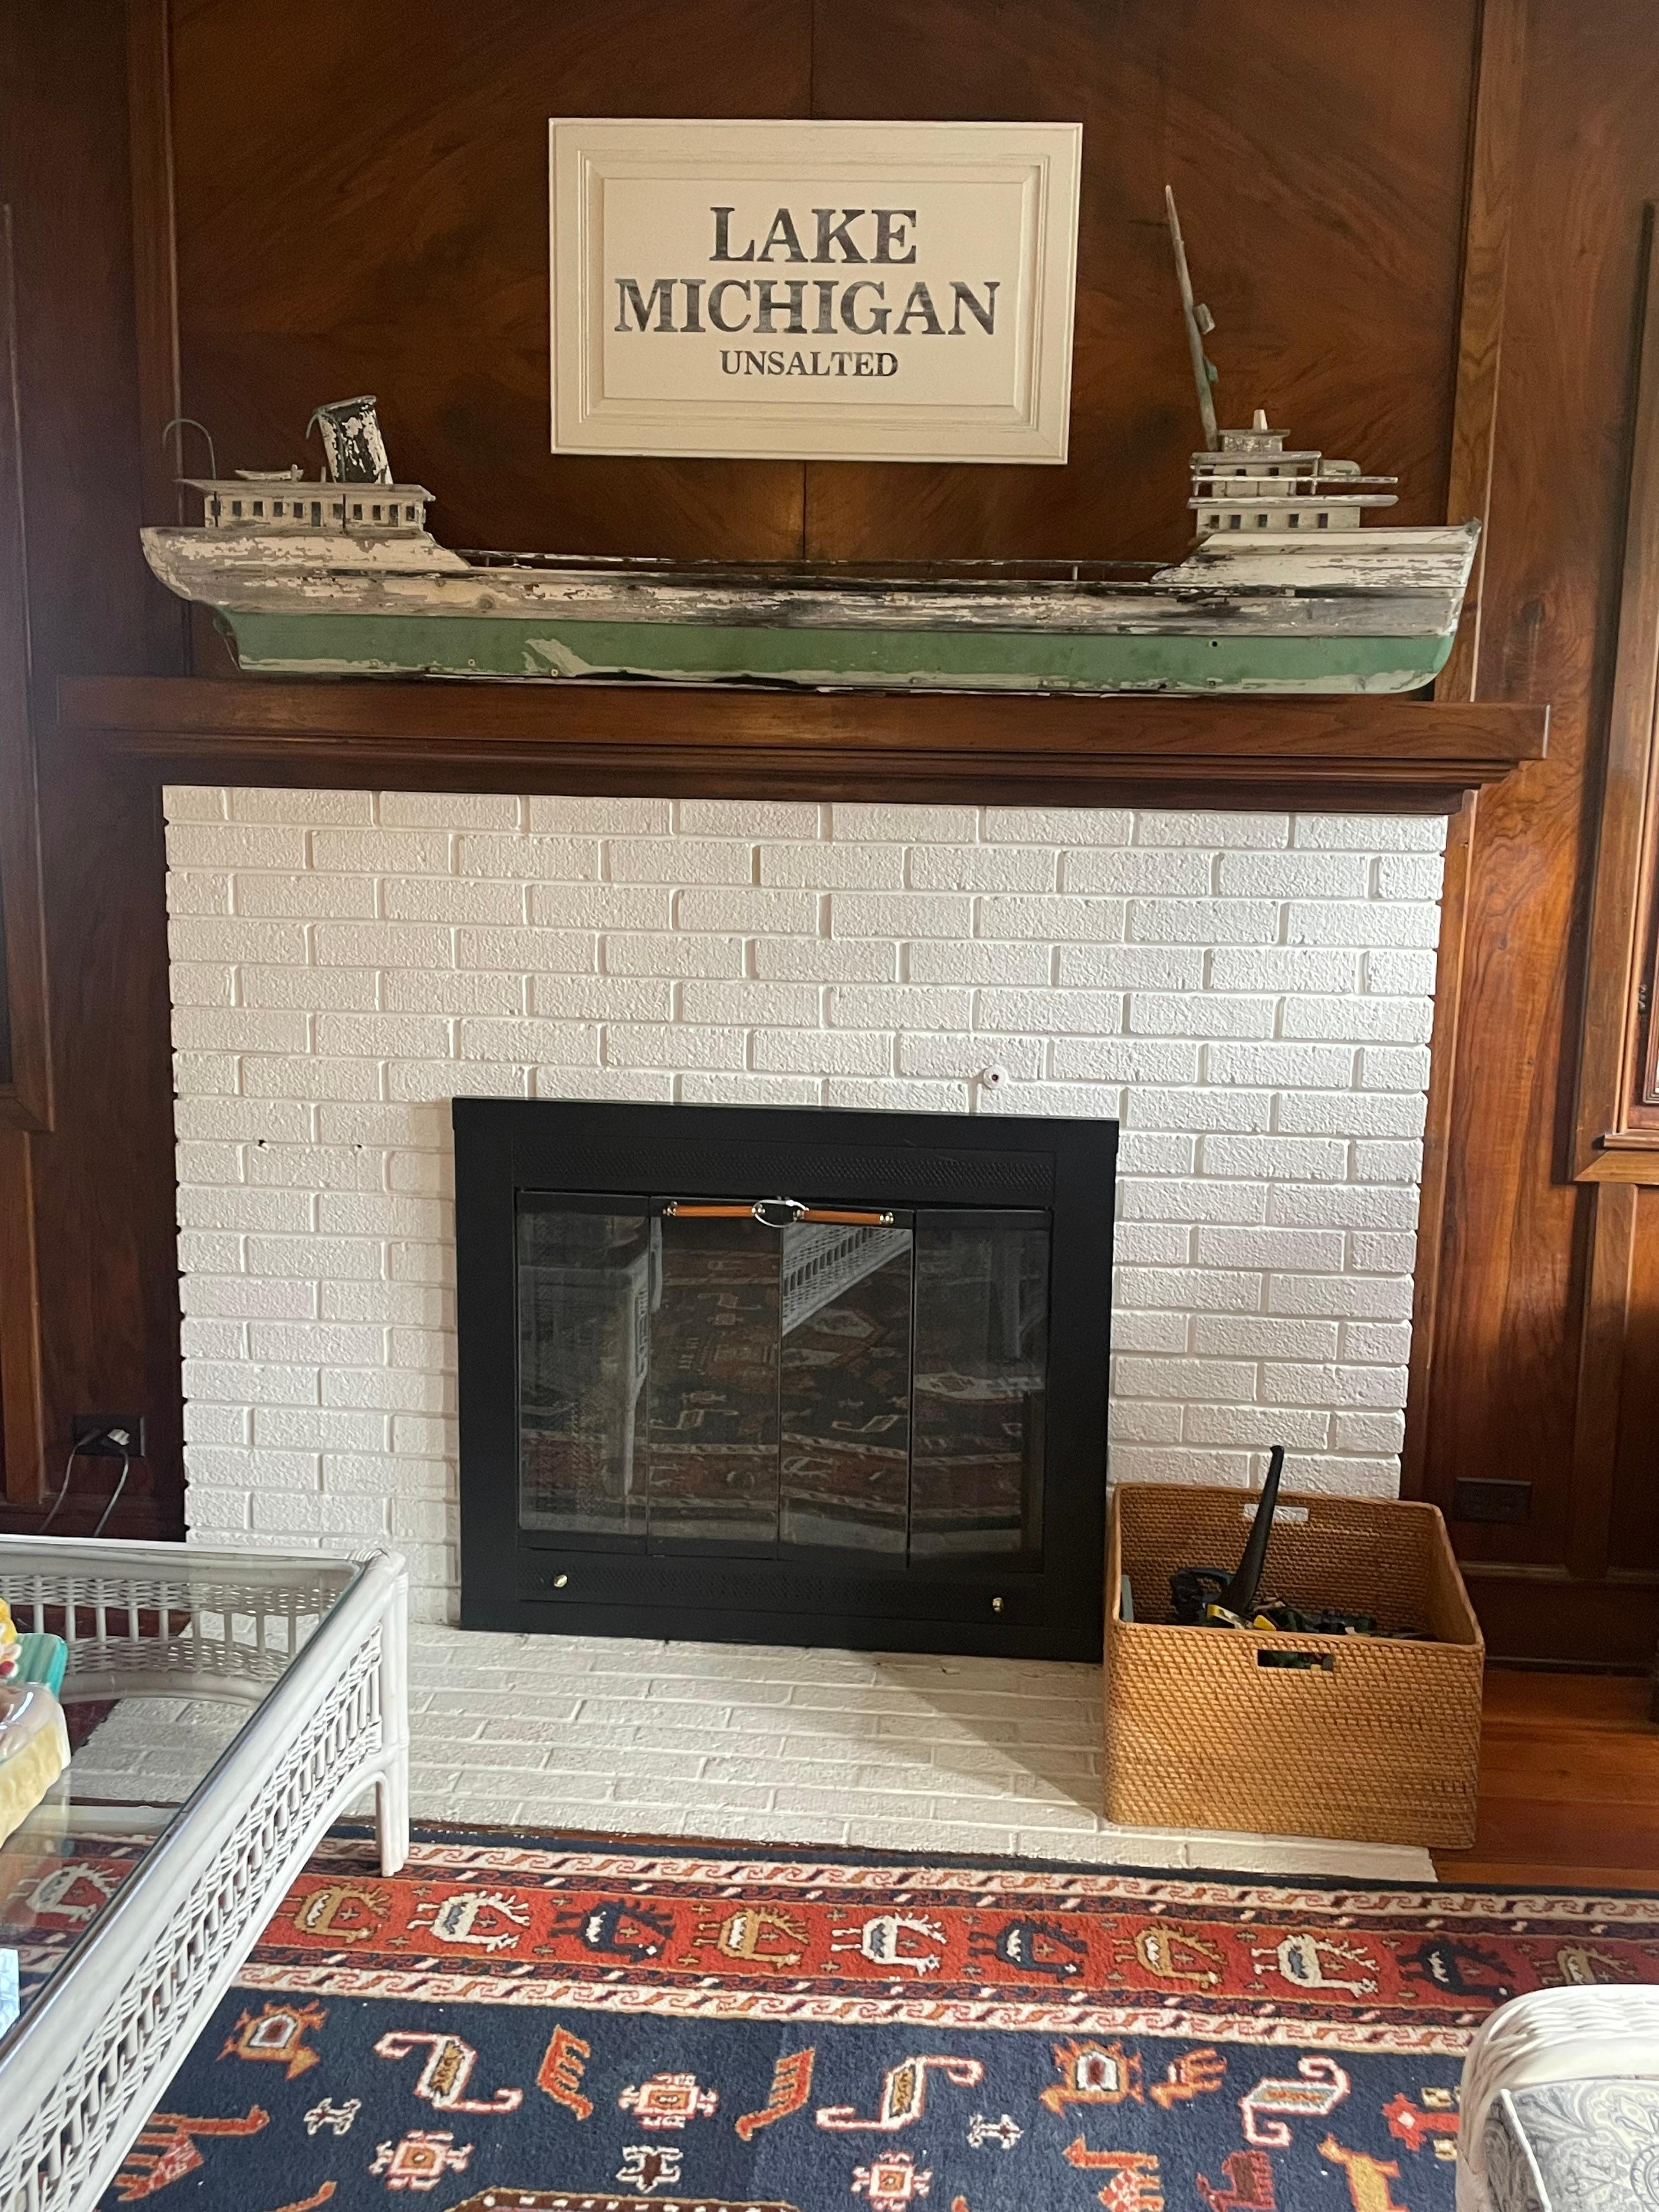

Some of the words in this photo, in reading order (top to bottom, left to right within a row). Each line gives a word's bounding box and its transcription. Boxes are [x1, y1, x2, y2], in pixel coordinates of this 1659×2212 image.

[709, 207, 917, 264] LAKE
[614, 278, 1001, 335] MICHIGAN
[719, 350, 898, 377] UNSALTED
